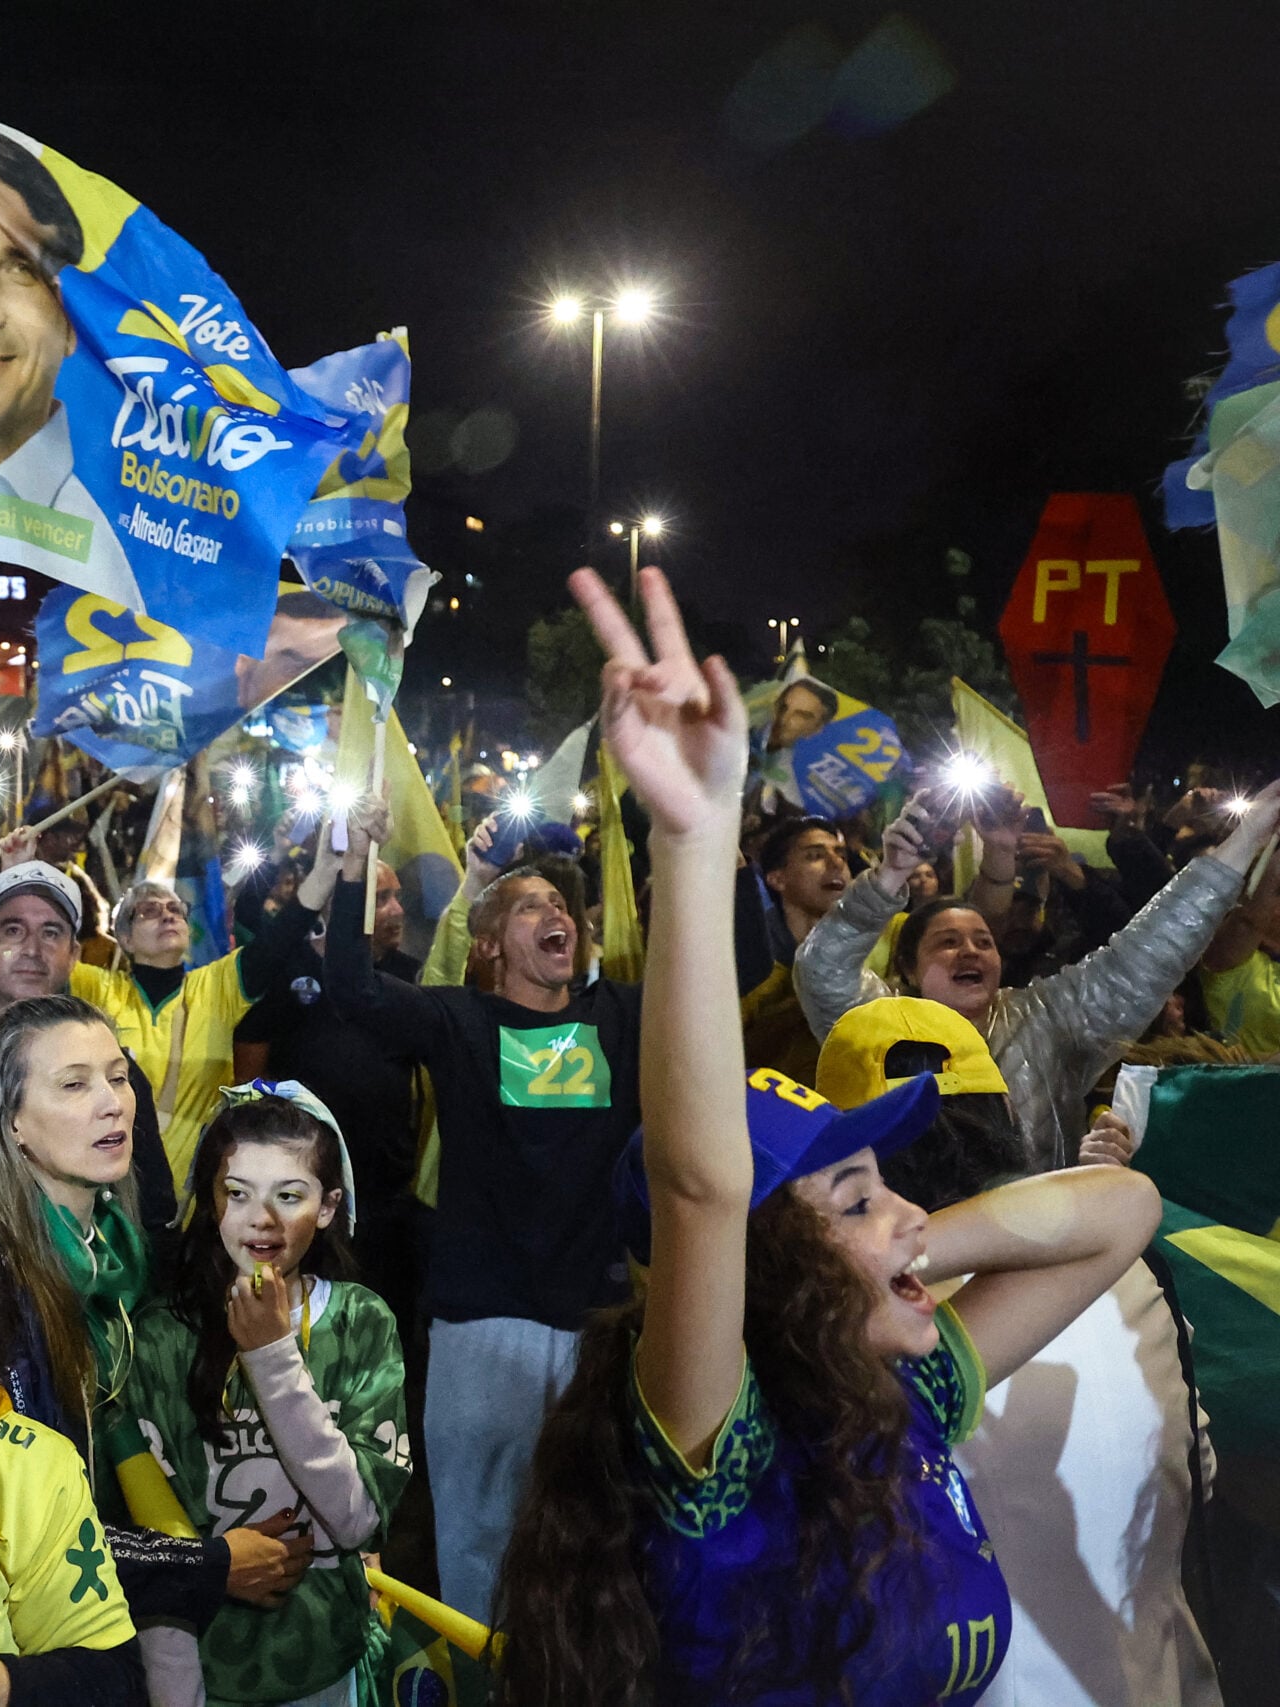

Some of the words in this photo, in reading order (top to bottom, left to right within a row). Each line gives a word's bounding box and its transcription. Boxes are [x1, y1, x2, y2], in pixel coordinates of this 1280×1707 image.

[179, 294, 250, 360] Vote
[121, 451, 239, 520] Bolsonaro
[23, 515, 86, 551] vencer
[128, 502, 173, 550] Alfredo
[174, 519, 222, 564] Gaspar
[1033, 560, 1140, 625] PT
[527, 1046, 596, 1095] 22
[936, 1614, 996, 1701] 10
